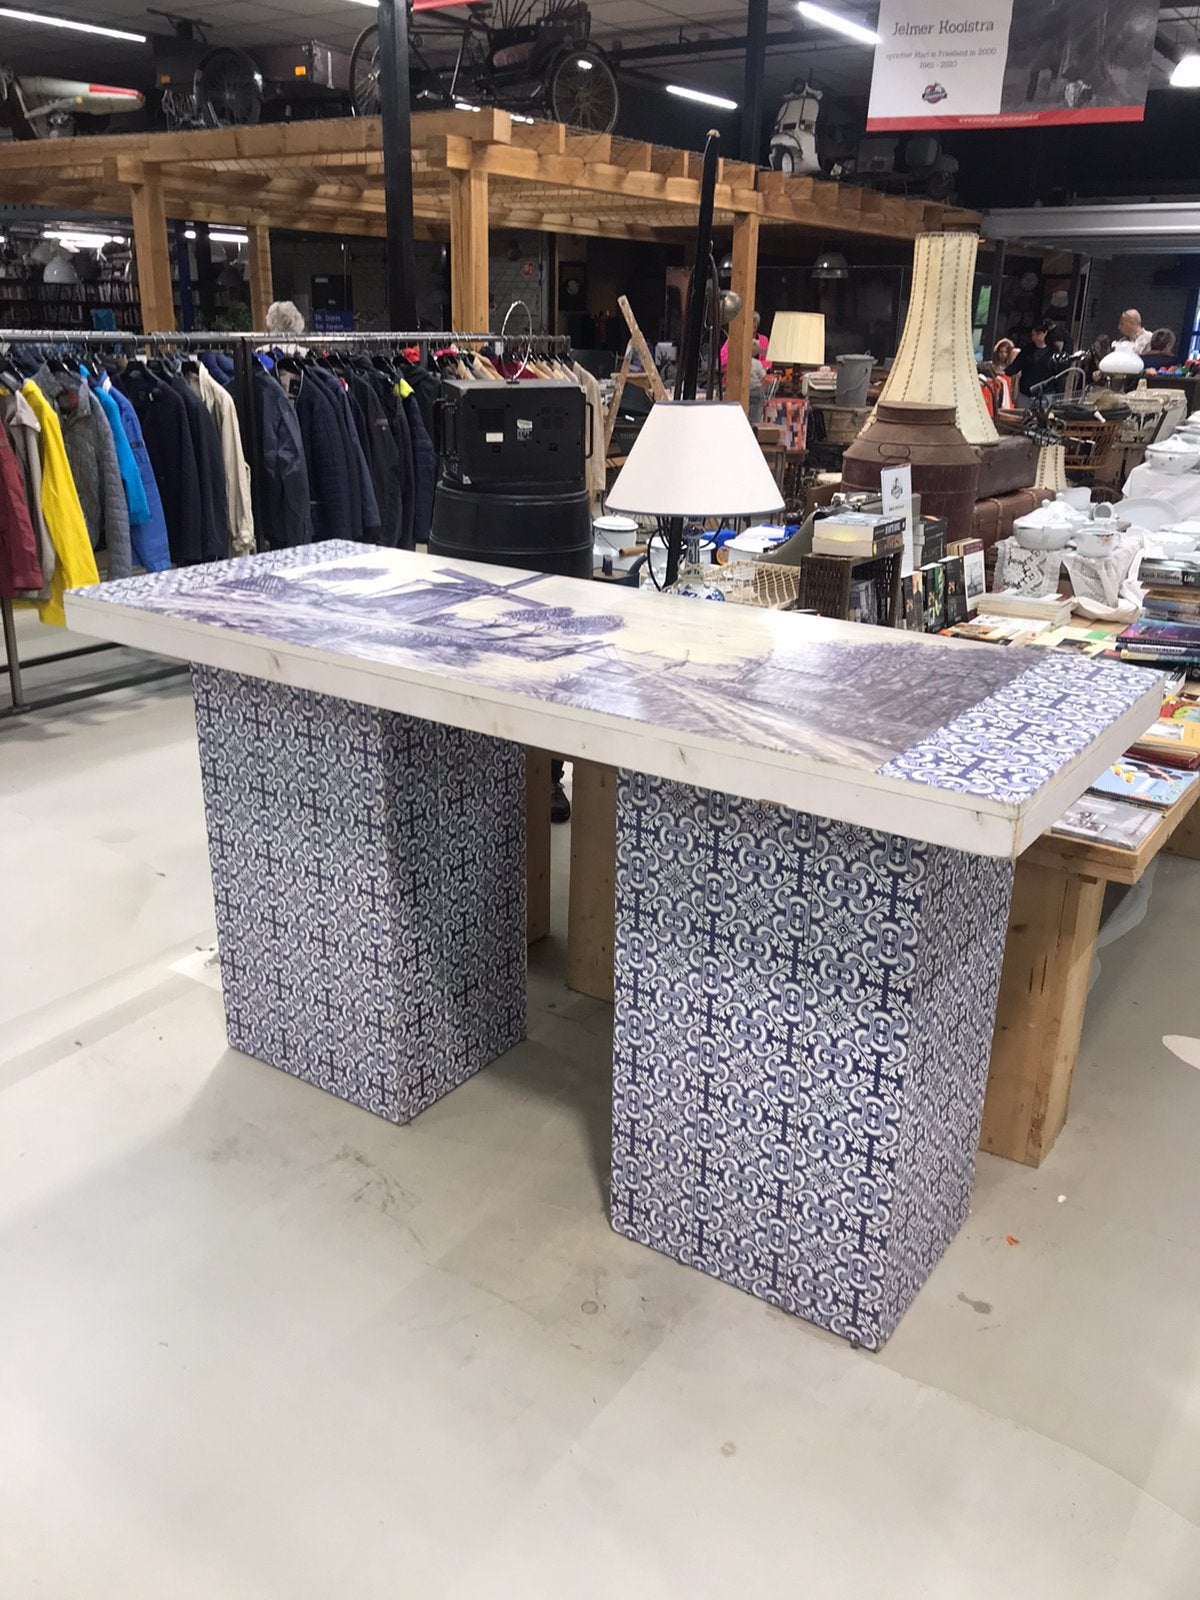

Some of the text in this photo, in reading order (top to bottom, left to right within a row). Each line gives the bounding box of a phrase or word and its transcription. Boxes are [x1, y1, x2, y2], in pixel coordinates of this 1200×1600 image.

[892, 20, 994, 36] Jelmer Kooistra
[978, 48, 997, 56] 2000
[325, 313, 341, 321] ben
[1184, 574, 1195, 583] Life
